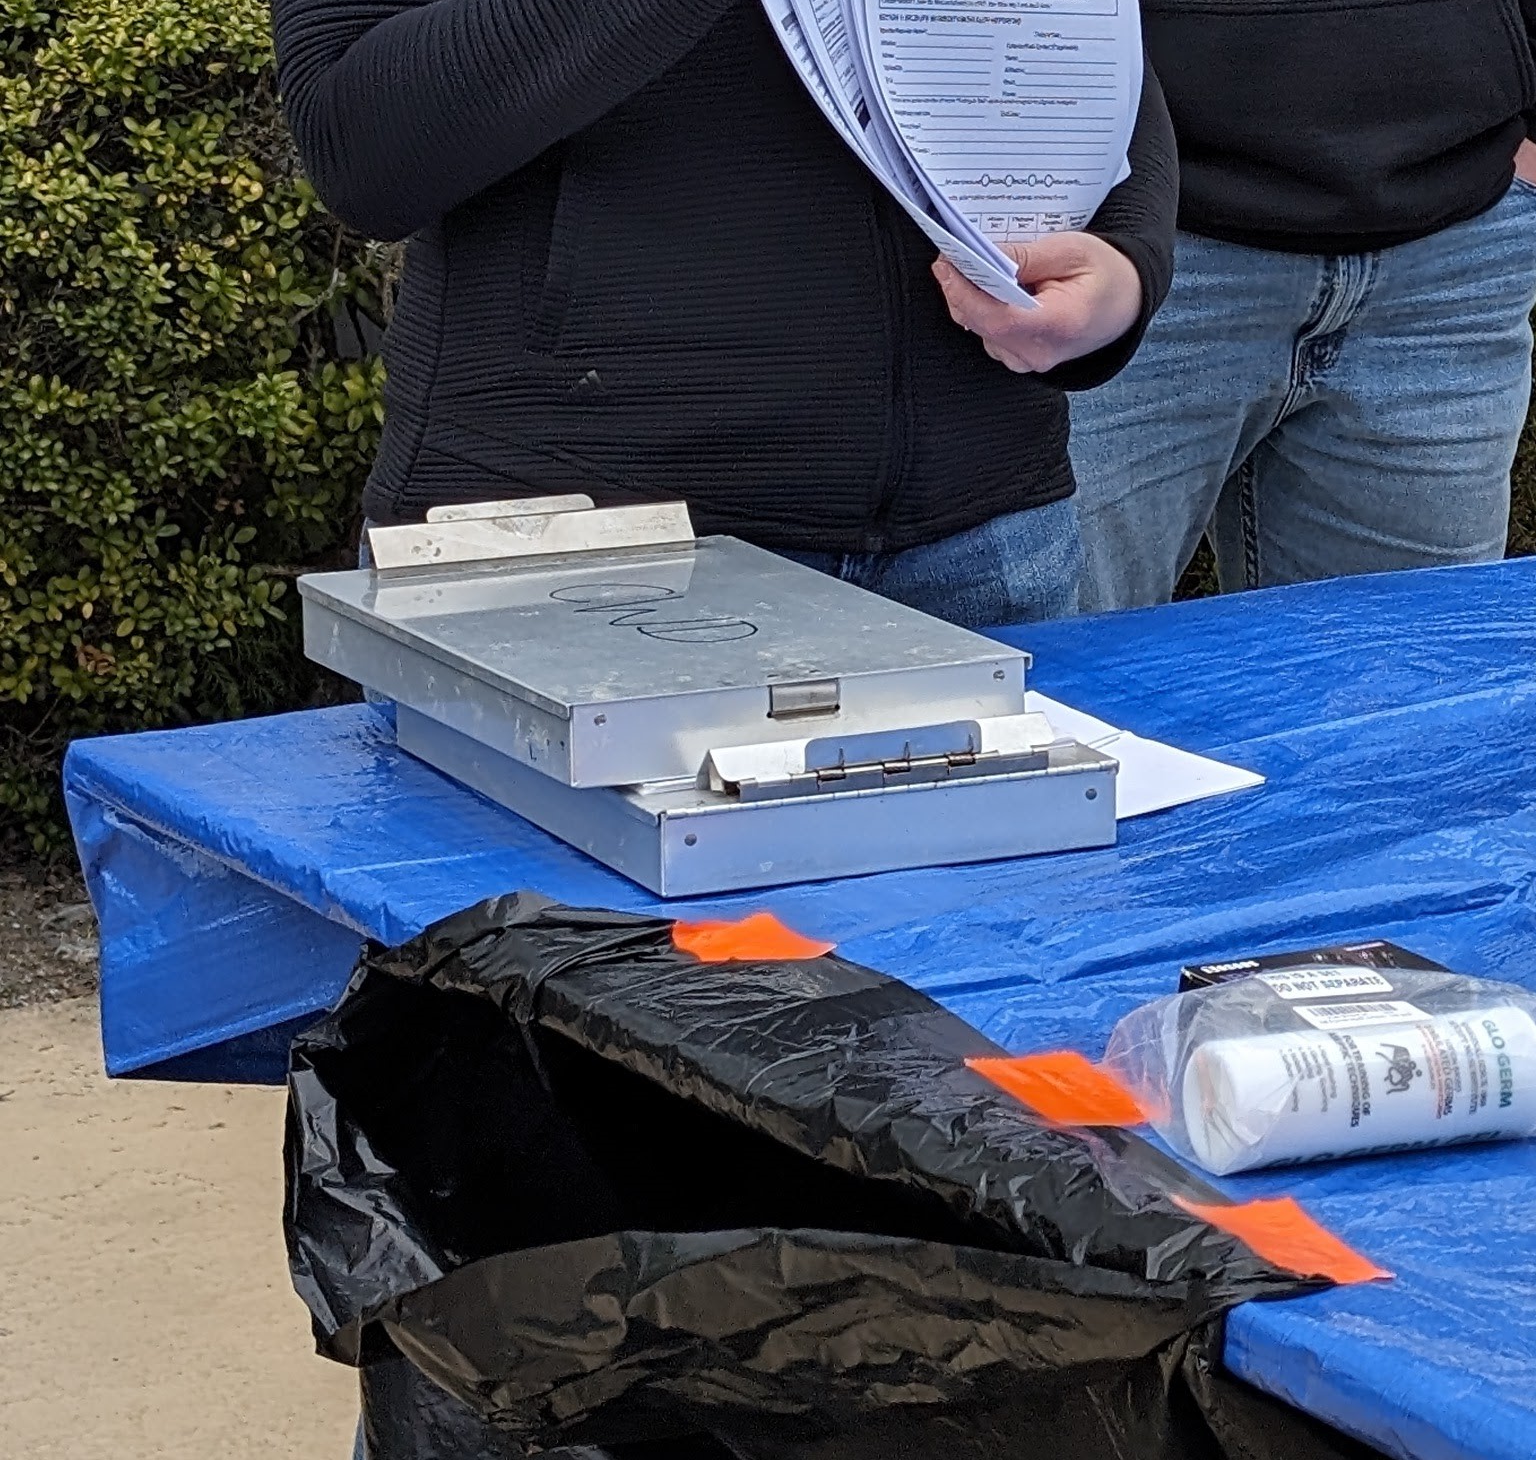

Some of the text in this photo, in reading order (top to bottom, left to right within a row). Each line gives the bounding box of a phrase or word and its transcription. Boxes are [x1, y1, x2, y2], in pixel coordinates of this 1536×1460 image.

[1272, 976, 1384, 993] DO NOT SEPARATE
[1353, 1050, 1370, 1100] TRAINING
[1482, 1019, 1513, 1108] GLO GERM
[1347, 1061, 1360, 1127] TECHNIQUES
